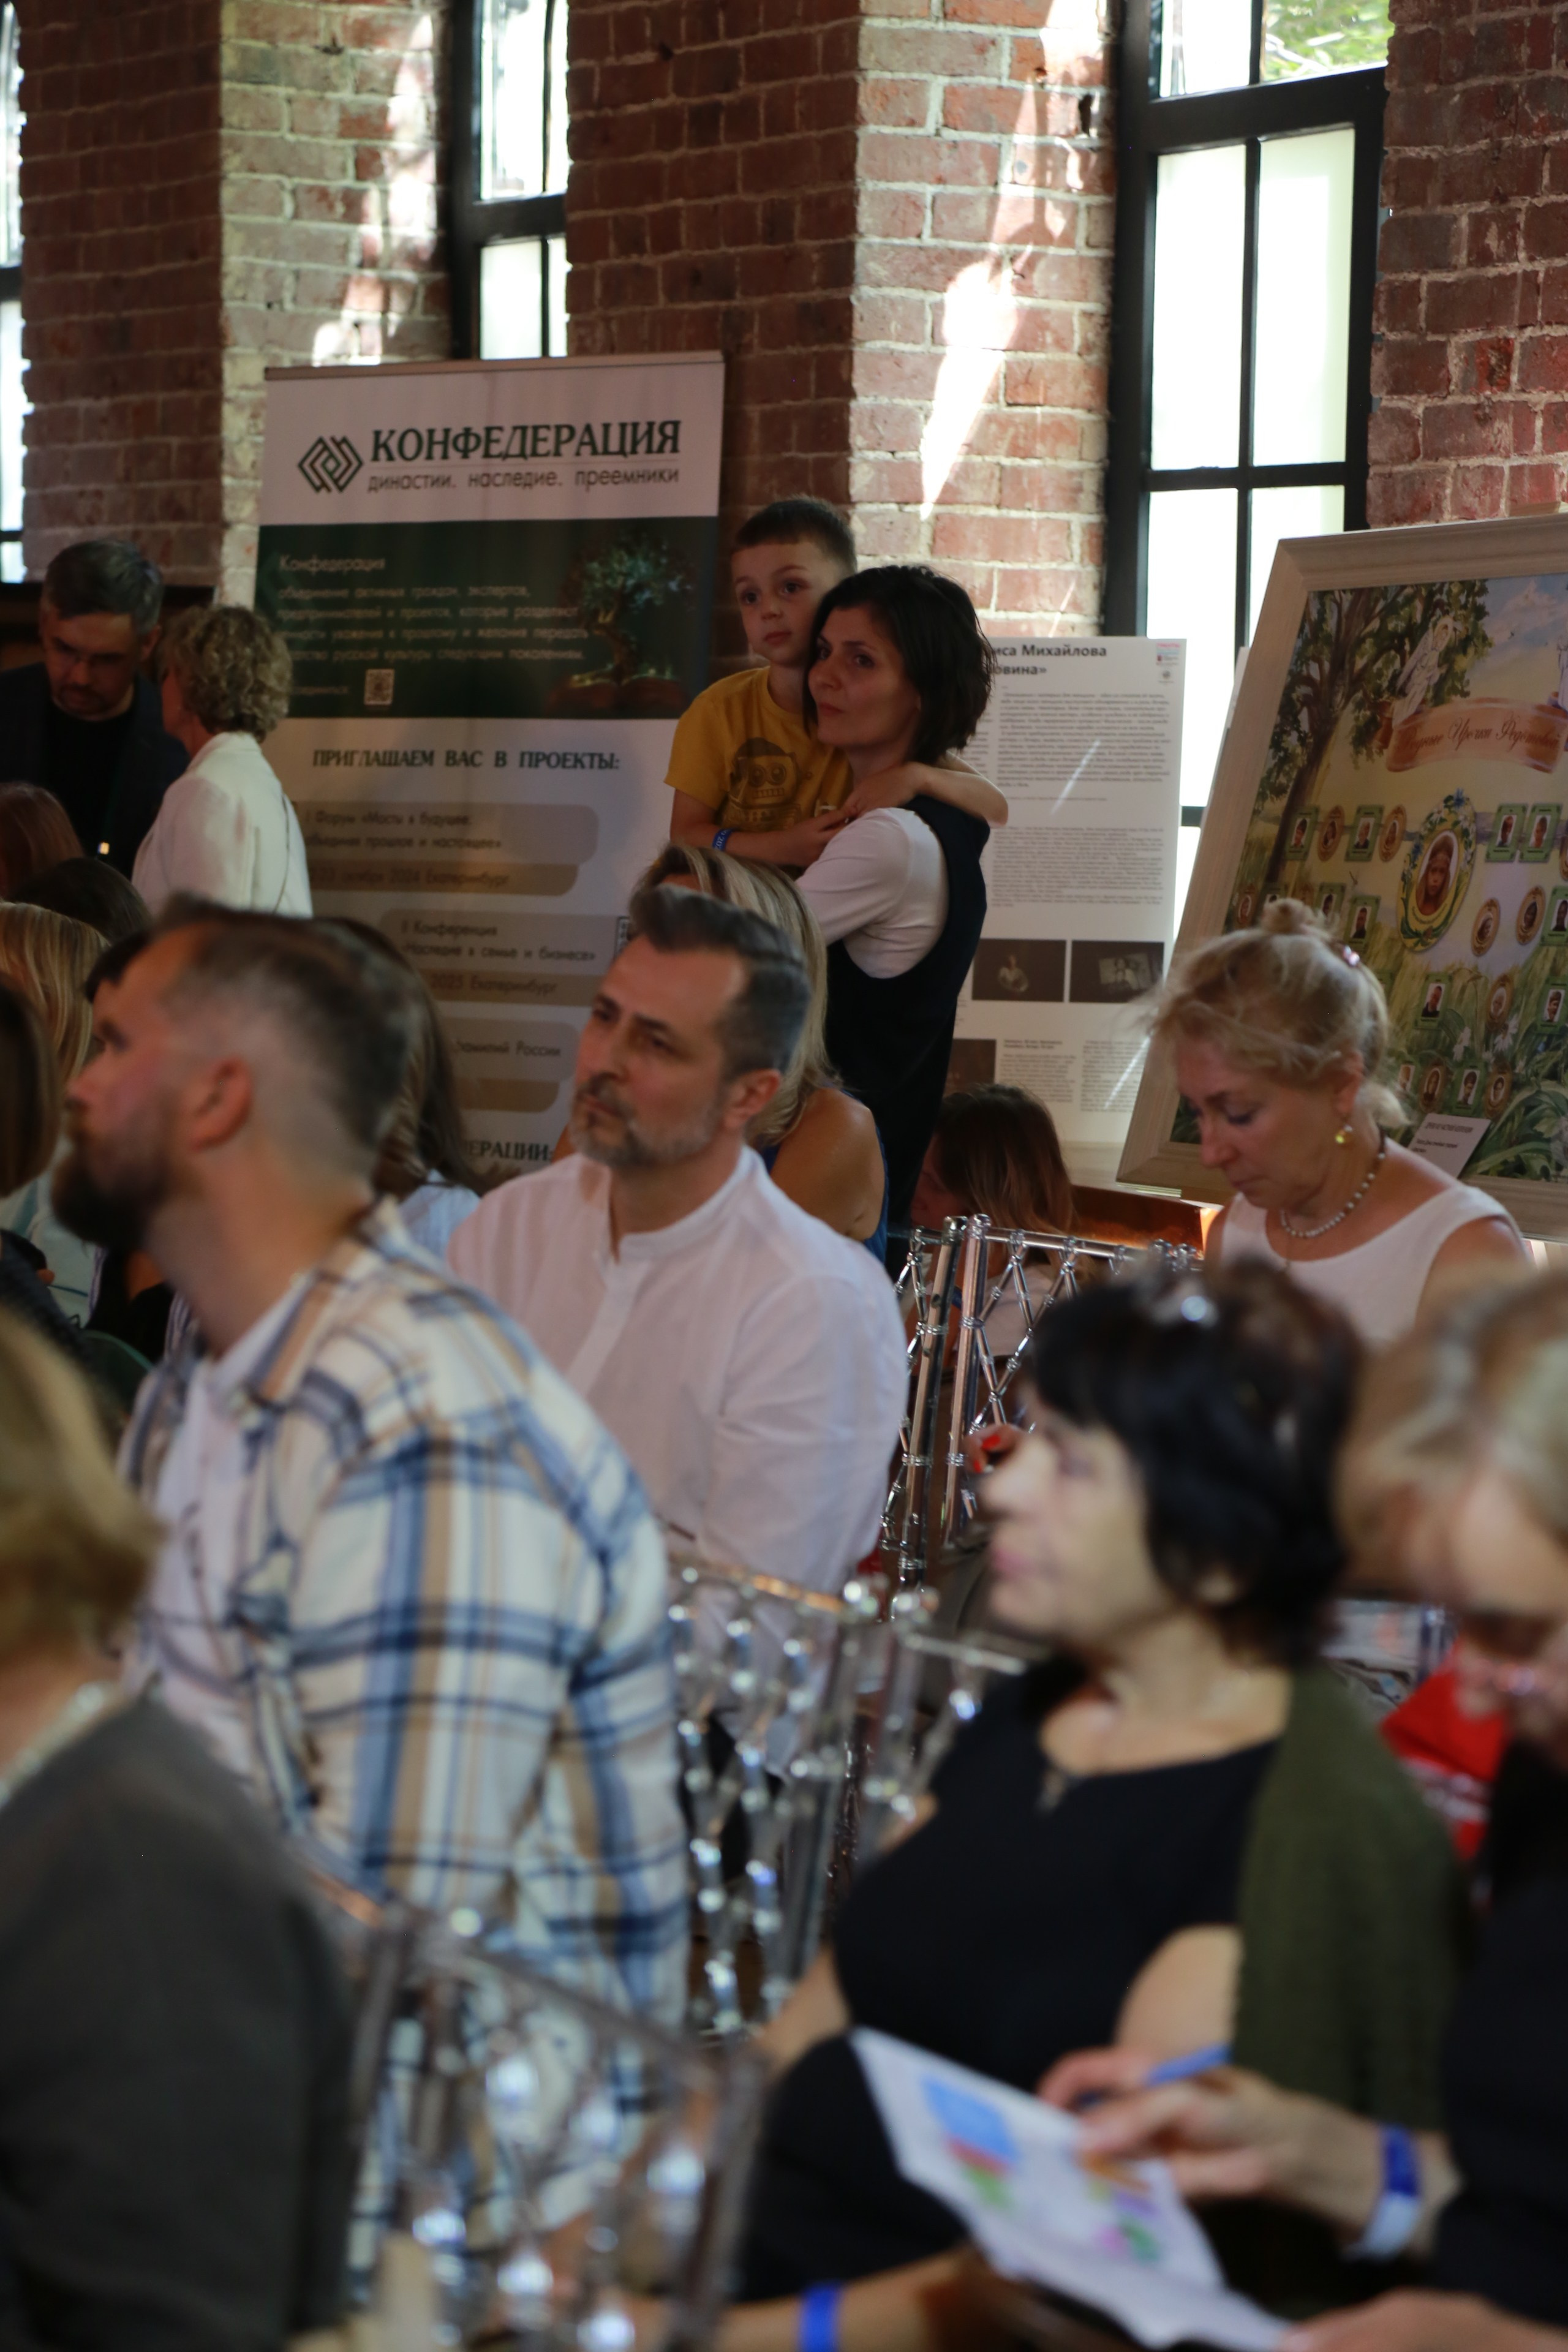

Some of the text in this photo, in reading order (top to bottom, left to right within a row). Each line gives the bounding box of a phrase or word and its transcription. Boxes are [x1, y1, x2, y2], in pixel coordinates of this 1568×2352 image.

[371, 420, 681, 461] КОНФЕДЕРАЦИЯ
[368, 468, 679, 492] династии. наследие. преемники
[1022, 644, 1107, 656] Михайлова
[313, 749, 619, 769] ПРИГЛАШАЕМ ВАС В ПРОЕКТЫ:
[414, 921, 497, 937] Конференция
[470, 974, 557, 995] Екатеринбург
[466, 1140, 554, 1161] ЕРАЦИИ:
